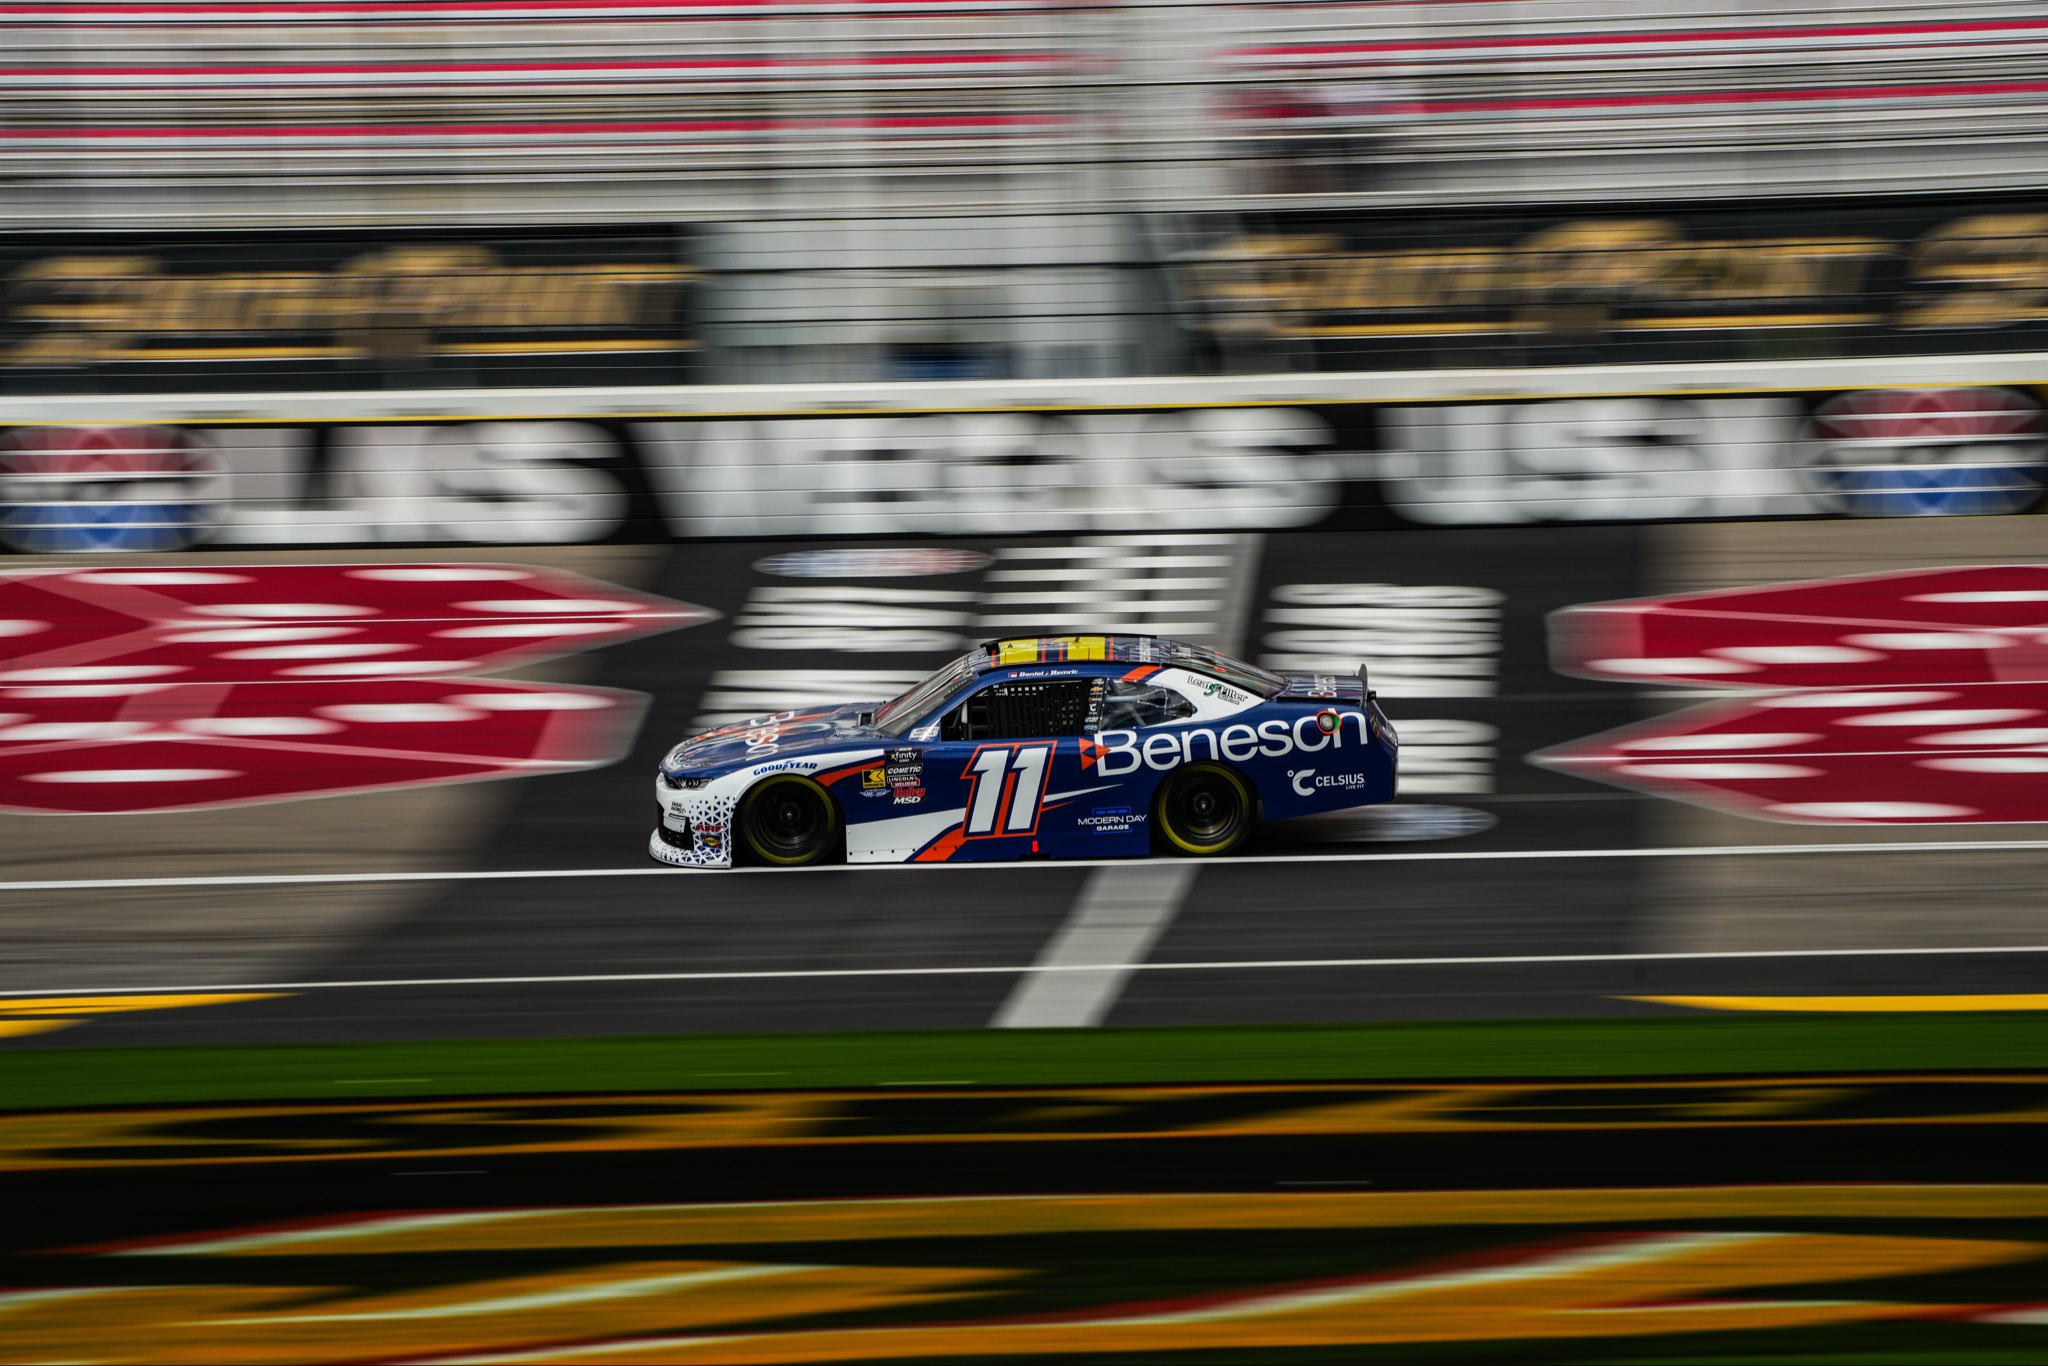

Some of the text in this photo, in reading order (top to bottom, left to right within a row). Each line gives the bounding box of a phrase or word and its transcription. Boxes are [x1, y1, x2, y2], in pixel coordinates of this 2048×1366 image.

[1094, 708, 1368, 777] Beneson
[890, 751, 917, 761] xfinity
[887, 766, 921, 774] COMETIC
[1315, 773, 1366, 787] CELSIUS
[966, 747, 1049, 834] 11
[893, 796, 921, 805] MSD
[1077, 814, 1147, 826] MODERN DAY
[1096, 824, 1130, 832] GARAGE
